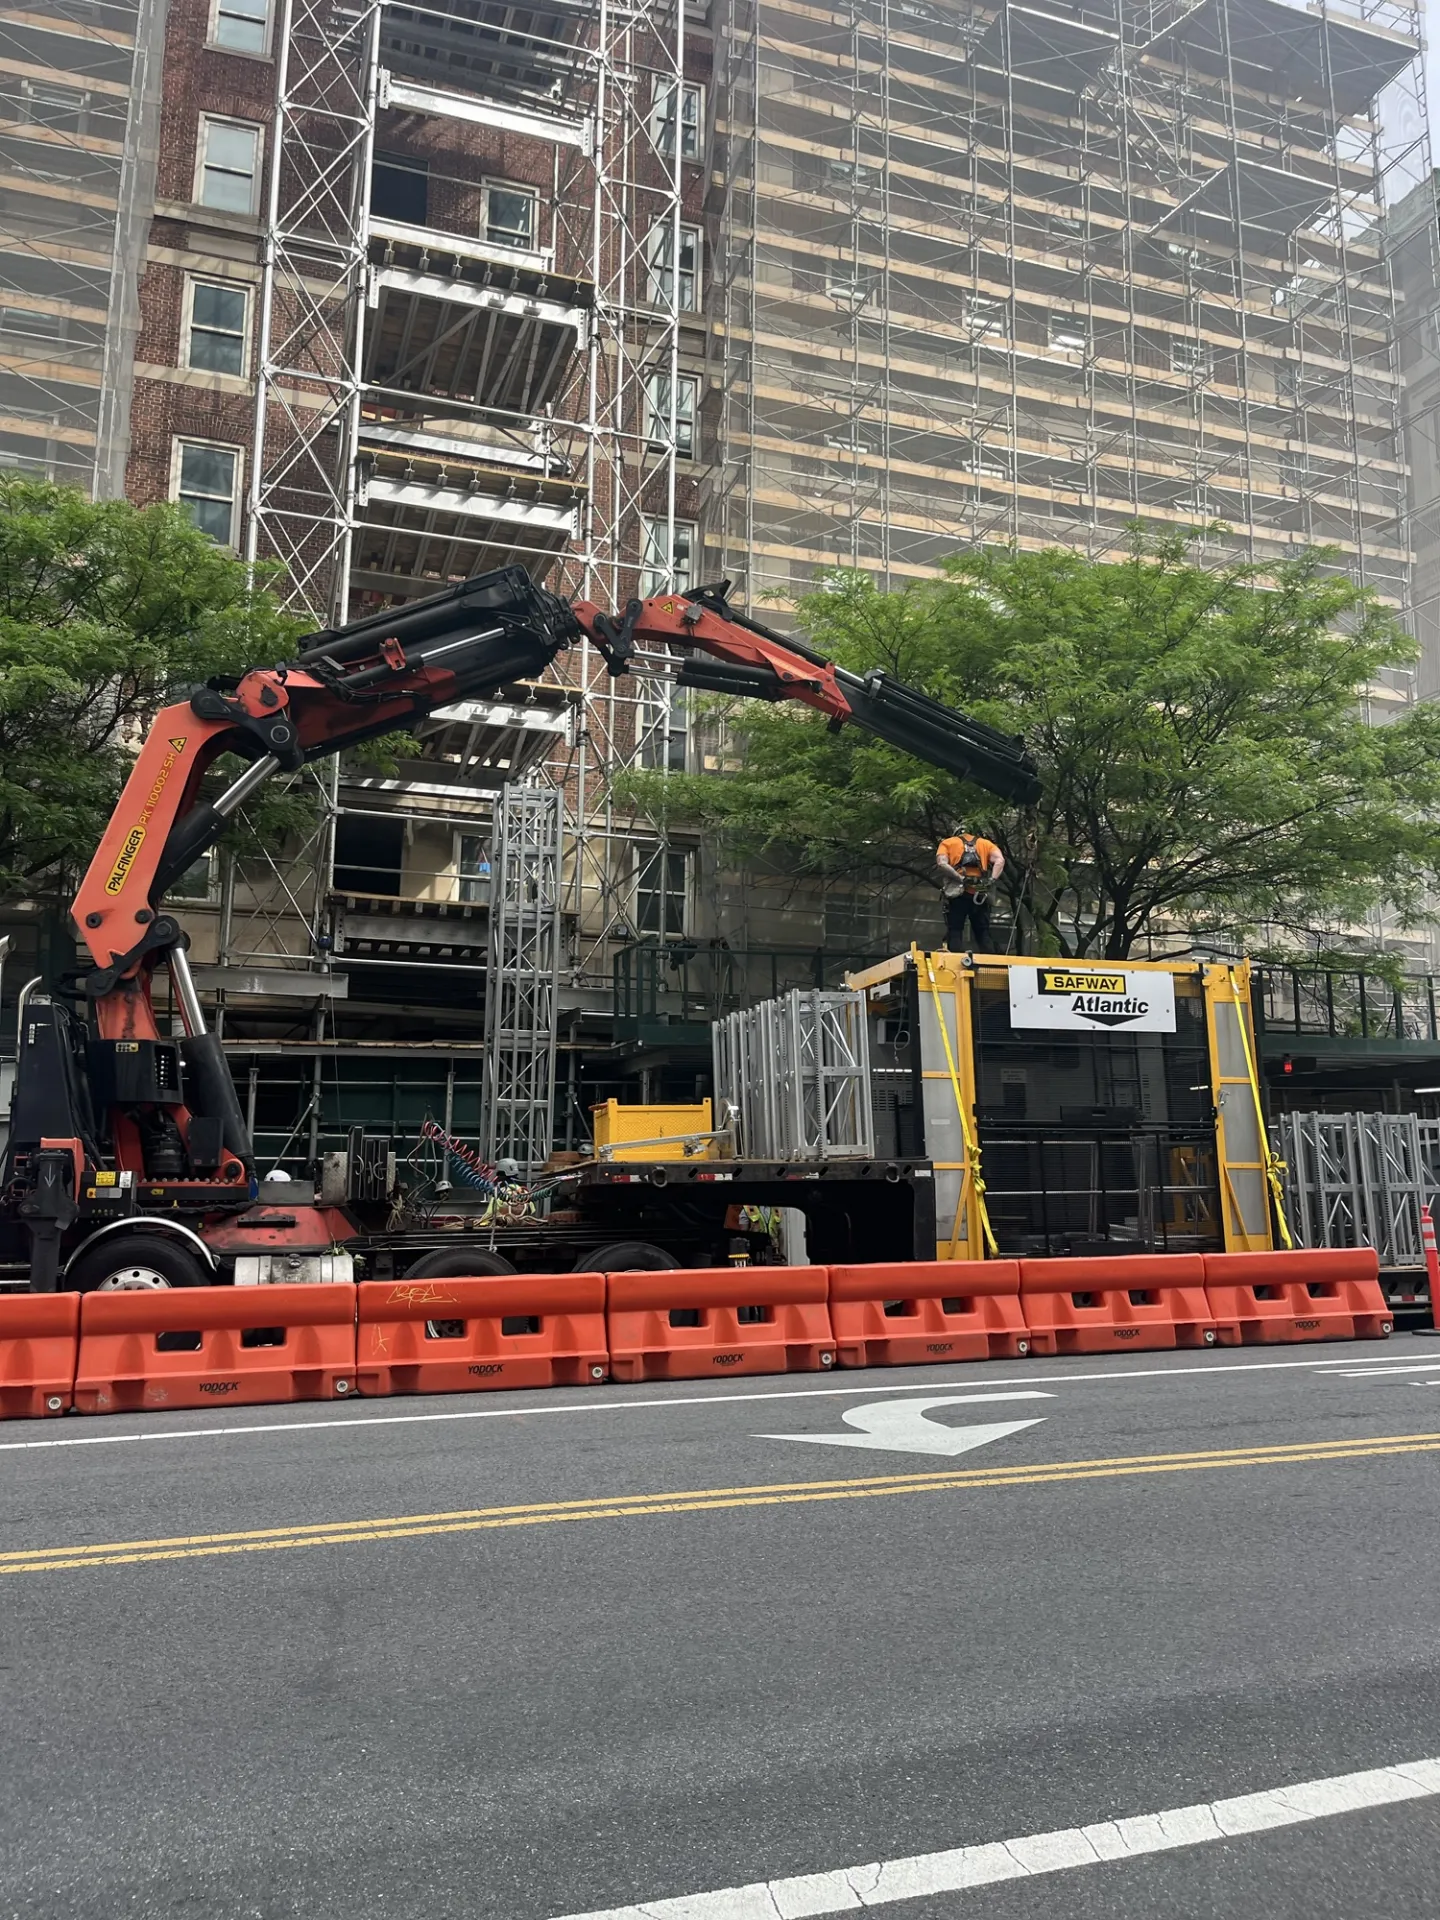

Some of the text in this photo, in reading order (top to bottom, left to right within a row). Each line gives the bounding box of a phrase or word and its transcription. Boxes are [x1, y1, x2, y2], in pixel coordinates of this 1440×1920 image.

[107, 829, 143, 892] PALFINGER
[138, 808, 153, 825] PK
[1053, 976, 1119, 990] SAFWAY
[1071, 995, 1149, 1014] Atlantic
[712, 1353, 744, 1364] YODOCK
[468, 1363, 505, 1375] YODOCK
[199, 1381, 240, 1392] YODOCK
